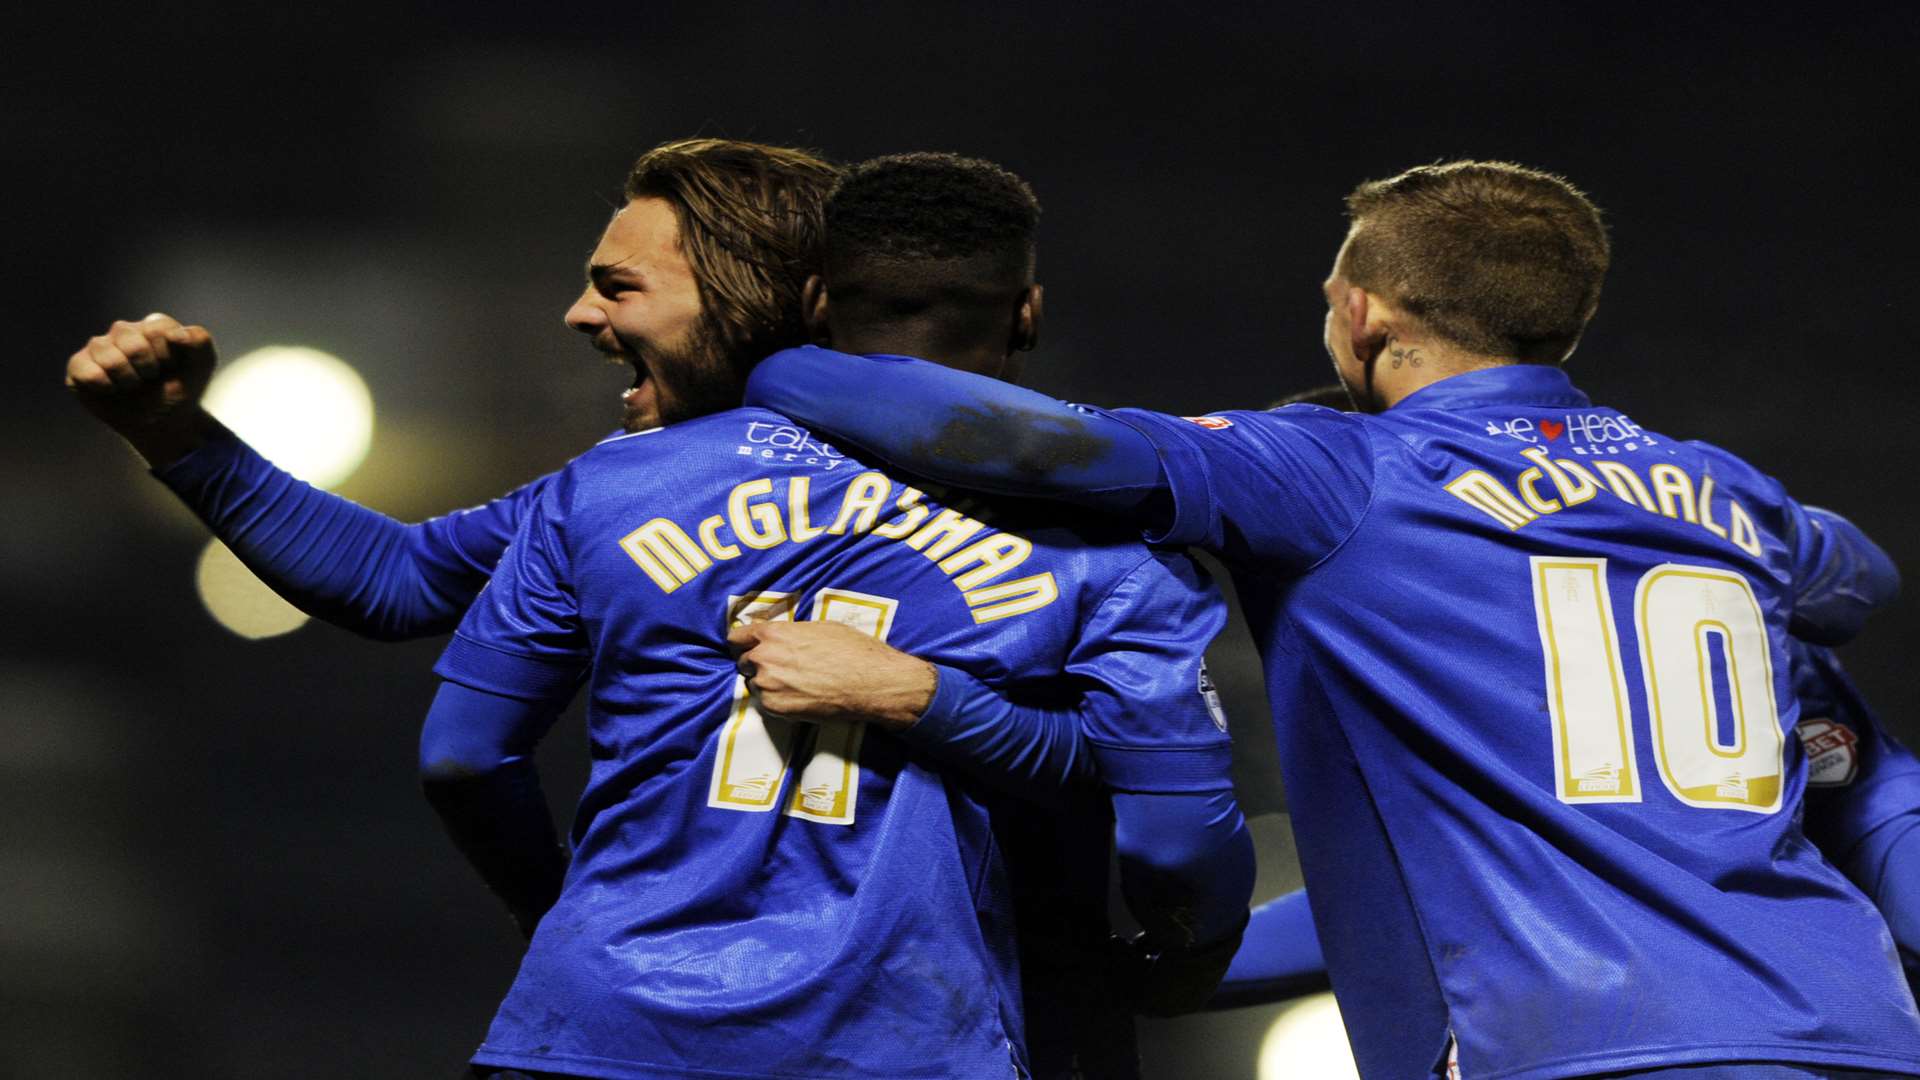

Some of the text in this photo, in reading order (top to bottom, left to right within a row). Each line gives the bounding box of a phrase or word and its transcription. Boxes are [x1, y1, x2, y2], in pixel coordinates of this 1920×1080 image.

[1566, 414, 1642, 444] Hear
[737, 445, 843, 470] mercy
[1529, 556, 1784, 814] 10
